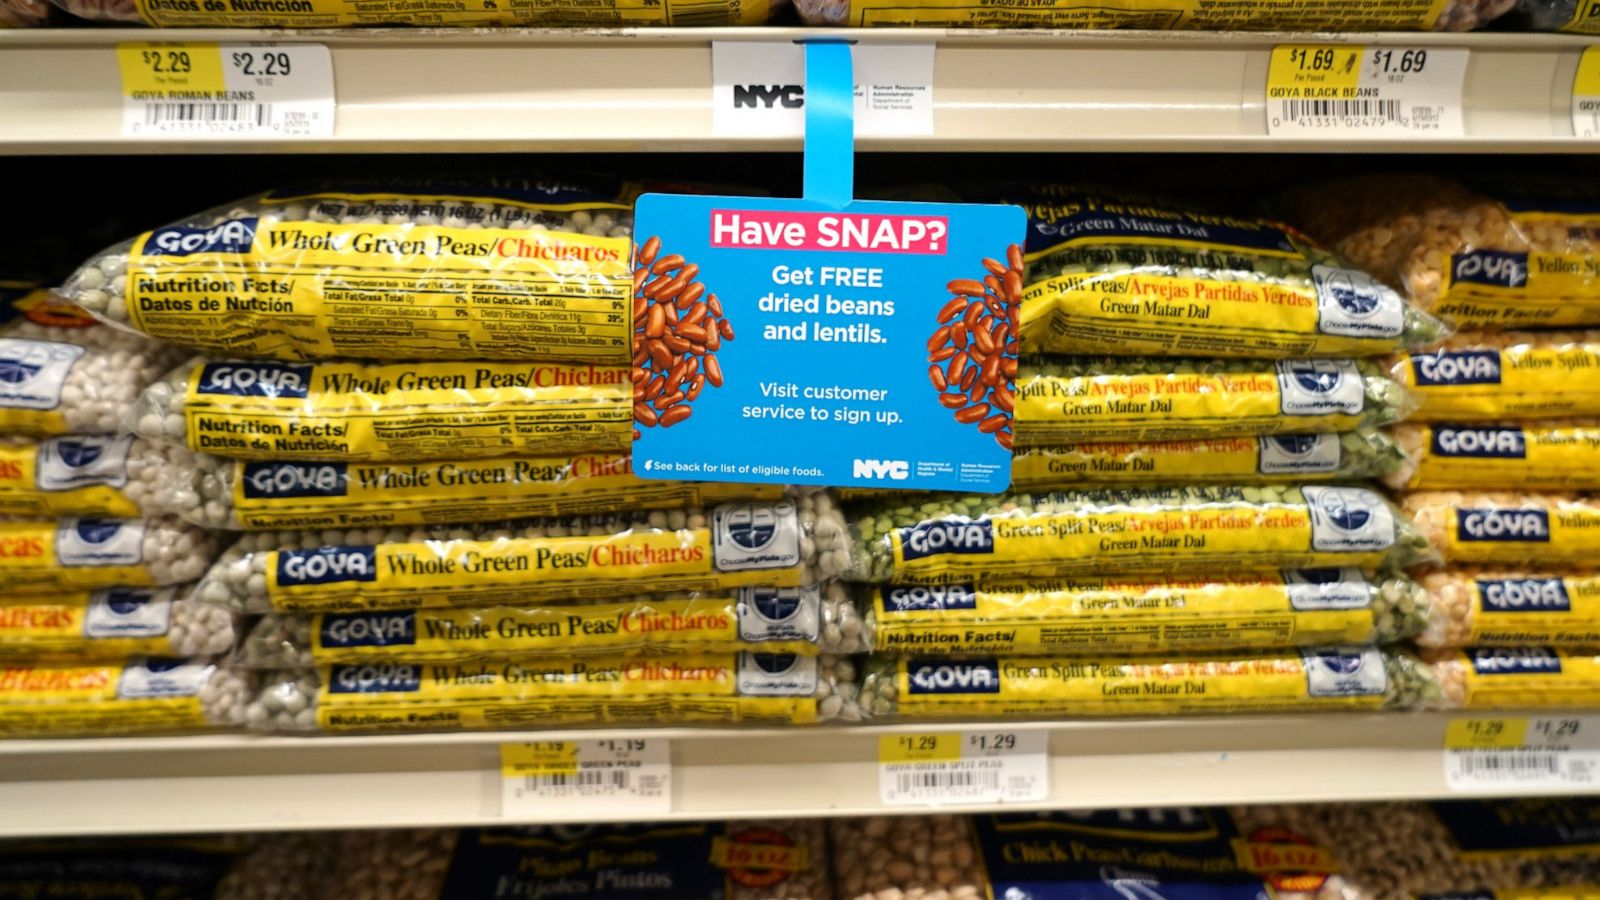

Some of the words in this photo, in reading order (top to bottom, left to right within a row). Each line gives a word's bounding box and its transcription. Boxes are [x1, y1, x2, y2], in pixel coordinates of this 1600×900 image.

[143, 51, 191, 73] $2.29
[232, 53, 291, 76] $2.29
[1290, 50, 1334, 70] $1.69
[1373, 50, 1427, 73] $1.69
[133, 91, 164, 101] GOYA
[169, 91, 211, 101] ROMAN
[216, 91, 255, 101] BEANS
[734, 85, 804, 108] NYC
[1271, 88, 1299, 97] GOYA
[1304, 88, 1338, 97] BLACK
[1343, 88, 1379, 97] BEANS
[1299, 118, 1337, 128] 41331
[449, 206, 467, 219] 16
[469, 207, 484, 219] OZ
[156, 220, 243, 252] GOYA
[714, 214, 806, 247] Have
[817, 217, 946, 250] SNAP?
[1060, 217, 1115, 237] Green
[1119, 217, 1173, 233] Matar
[1177, 223, 1210, 238] Dal
[1537, 256, 1579, 273] Yellow
[139, 278, 235, 293] Nutrition
[243, 279, 295, 296] Fcts/
[772, 265, 813, 286] Get
[820, 267, 883, 288] FREE
[323, 292, 343, 300] Total
[345, 293, 382, 302] Fat/Grasa
[384, 294, 404, 302] Total
[455, 295, 468, 303] 0%
[472, 296, 491, 304] Total
[535, 298, 553, 306] Total
[1047, 277, 1086, 294] Split
[1195, 282, 1259, 302] Partidas
[1262, 286, 1313, 308] Verdes
[140, 297, 192, 311] Datos
[199, 296, 221, 310] de
[456, 309, 468, 317] 0%
[758, 293, 819, 314] dried
[826, 295, 895, 316] beans
[1100, 297, 1139, 315] Green
[1143, 301, 1184, 318] Matar
[1187, 303, 1210, 319] Dal
[764, 321, 807, 341] and
[814, 322, 888, 344] lentils.
[1421, 355, 1491, 381] GOYA
[1510, 354, 1553, 369] Yellow
[1557, 353, 1590, 371] Split
[211, 367, 301, 390] GOYA
[323, 373, 390, 395] Whole
[396, 371, 467, 393] Green
[474, 365, 634, 389] Peas/Chichar
[1221, 375, 1273, 393] Verdes
[760, 382, 799, 398] Visit
[803, 385, 888, 401] customer
[742, 404, 805, 420] service
[811, 405, 829, 420] to
[834, 406, 872, 425] sign
[876, 408, 903, 425] up.
[1063, 401, 1102, 416] Green
[1106, 400, 1147, 414] Matar
[1150, 399, 1172, 413] Dal
[200, 418, 282, 434] Nutrition
[289, 421, 349, 437] Facts/
[200, 435, 247, 448] Datos
[251, 438, 270, 451] de
[275, 438, 349, 453] Nutrición
[1438, 429, 1517, 453] GOYA
[357, 467, 430, 490] Whole
[437, 464, 506, 485] Green
[513, 452, 633, 482] Peas/Chic
[654, 461, 673, 471] See
[676, 461, 700, 472] back
[702, 462, 718, 472] for
[720, 463, 736, 473] list
[738, 464, 750, 474] of
[752, 464, 790, 477] eligible
[792, 466, 825, 477] foods.
[853, 459, 909, 480] NYC
[1048, 460, 1087, 473] Green
[1090, 458, 1129, 472] Matar
[1133, 457, 1154, 470] Dal
[252, 465, 337, 493] GOYA
[998, 522, 1044, 539] Green
[1049, 520, 1083, 539] Split
[1189, 512, 1250, 531] Partidas
[1464, 513, 1543, 537] GOYA
[910, 525, 985, 553] GOYA
[1100, 537, 1137, 551] Green
[1141, 536, 1180, 549] Matar
[1184, 535, 1205, 548] Dal
[285, 553, 368, 579] GOYA
[387, 553, 456, 575] Whole
[463, 550, 529, 573] Green
[536, 542, 704, 570] Peas/Chicharos
[890, 586, 967, 606] GOYA
[1487, 581, 1563, 608] GOYA
[329, 617, 408, 642] GOYA
[425, 619, 490, 640] Whole
[497, 616, 562, 639] Green
[568, 609, 728, 635] Peas/Chicharos
[888, 632, 960, 645] Nutrition
[965, 630, 1016, 643] Facts/
[338, 665, 418, 688] GOYA
[432, 665, 496, 685] Whole
[914, 665, 994, 690] GOYA
[1003, 662, 1048, 678] Green
[1052, 662, 1089, 681] Split
[1102, 682, 1139, 695] Green
[1142, 682, 1180, 695] Matar
[1184, 681, 1205, 695] Dal
[899, 736, 937, 750] $1.29
[970, 734, 1016, 750] $1.29
[595, 869, 672, 890] Pintos
